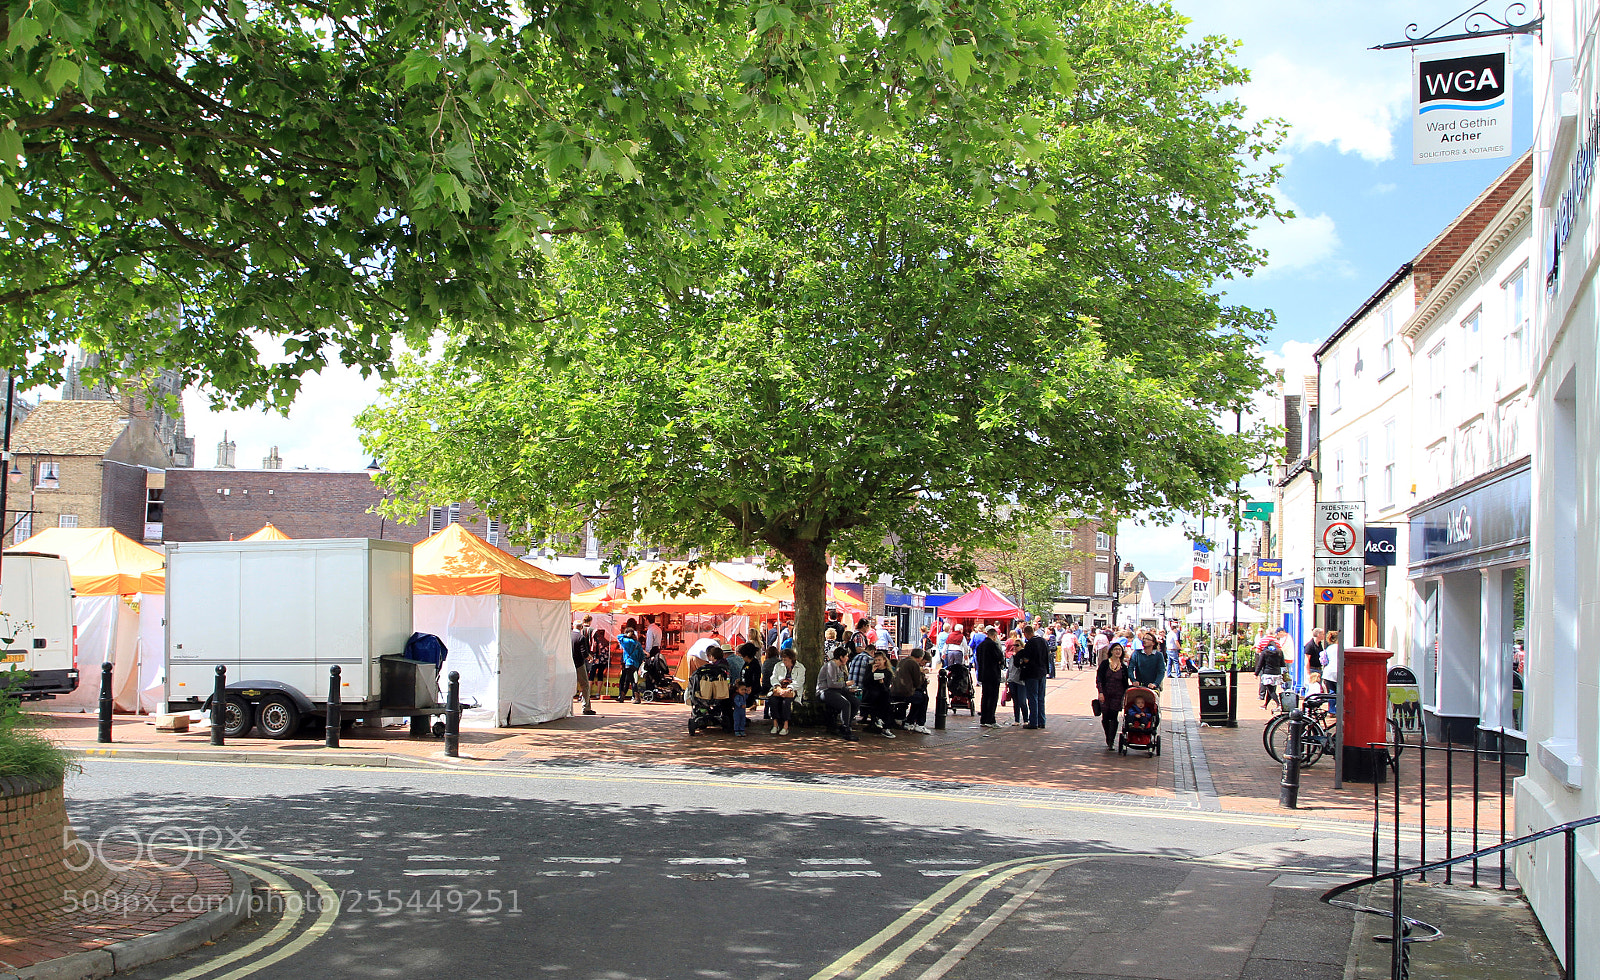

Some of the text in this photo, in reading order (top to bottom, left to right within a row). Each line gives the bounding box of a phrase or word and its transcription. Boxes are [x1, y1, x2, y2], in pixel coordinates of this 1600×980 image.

[1425, 67, 1499, 96] WGA
[1426, 117, 1497, 132] Ward Gethin
[1440, 131, 1482, 143] Archer
[1419, 149, 1460, 159] SOLICITORS
[1469, 145, 1505, 155] NOTARIES
[1326, 511, 1354, 521] ZONE
[1328, 559, 1350, 567] Except
[1193, 582, 1209, 592] ELY
